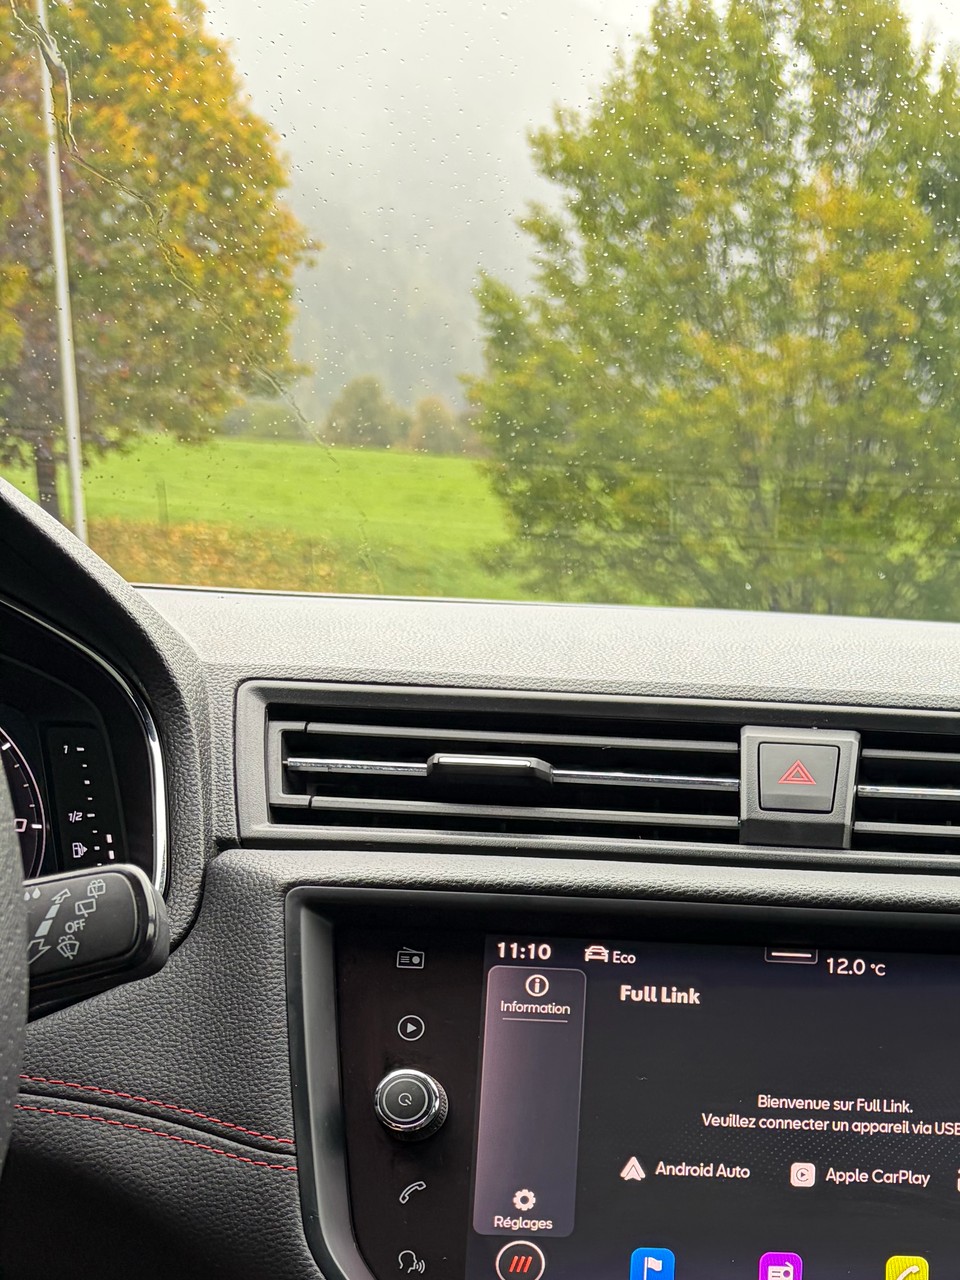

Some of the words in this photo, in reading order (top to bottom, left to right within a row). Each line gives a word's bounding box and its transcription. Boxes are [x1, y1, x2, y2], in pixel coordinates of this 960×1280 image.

[68, 811, 83, 823] 1/2
[64, 918, 87, 934] OFF
[497, 941, 552, 960] 11:10
[612, 950, 637, 965] Eco
[826, 957, 866, 976] 12.0
[870, 963, 887, 977] °C
[620, 984, 657, 1003] Full
[661, 986, 701, 1005] Link
[500, 1000, 571, 1015] Information
[757, 1094, 831, 1112] Bienvenue
[833, 1100, 854, 1112] sur
[856, 1097, 882, 1113] Full
[883, 1098, 914, 1114] Link.
[701, 1112, 756, 1129] Veuillez
[758, 1117, 830, 1132] connecter
[831, 1120, 849, 1133] un
[851, 1119, 909, 1137] appareil
[911, 1120, 932, 1135] via
[654, 1160, 713, 1178] Android
[715, 1163, 751, 1179] Auto
[825, 1167, 869, 1185] Apple
[871, 1168, 931, 1188] CarPlay
[493, 1215, 553, 1231] Réglages
